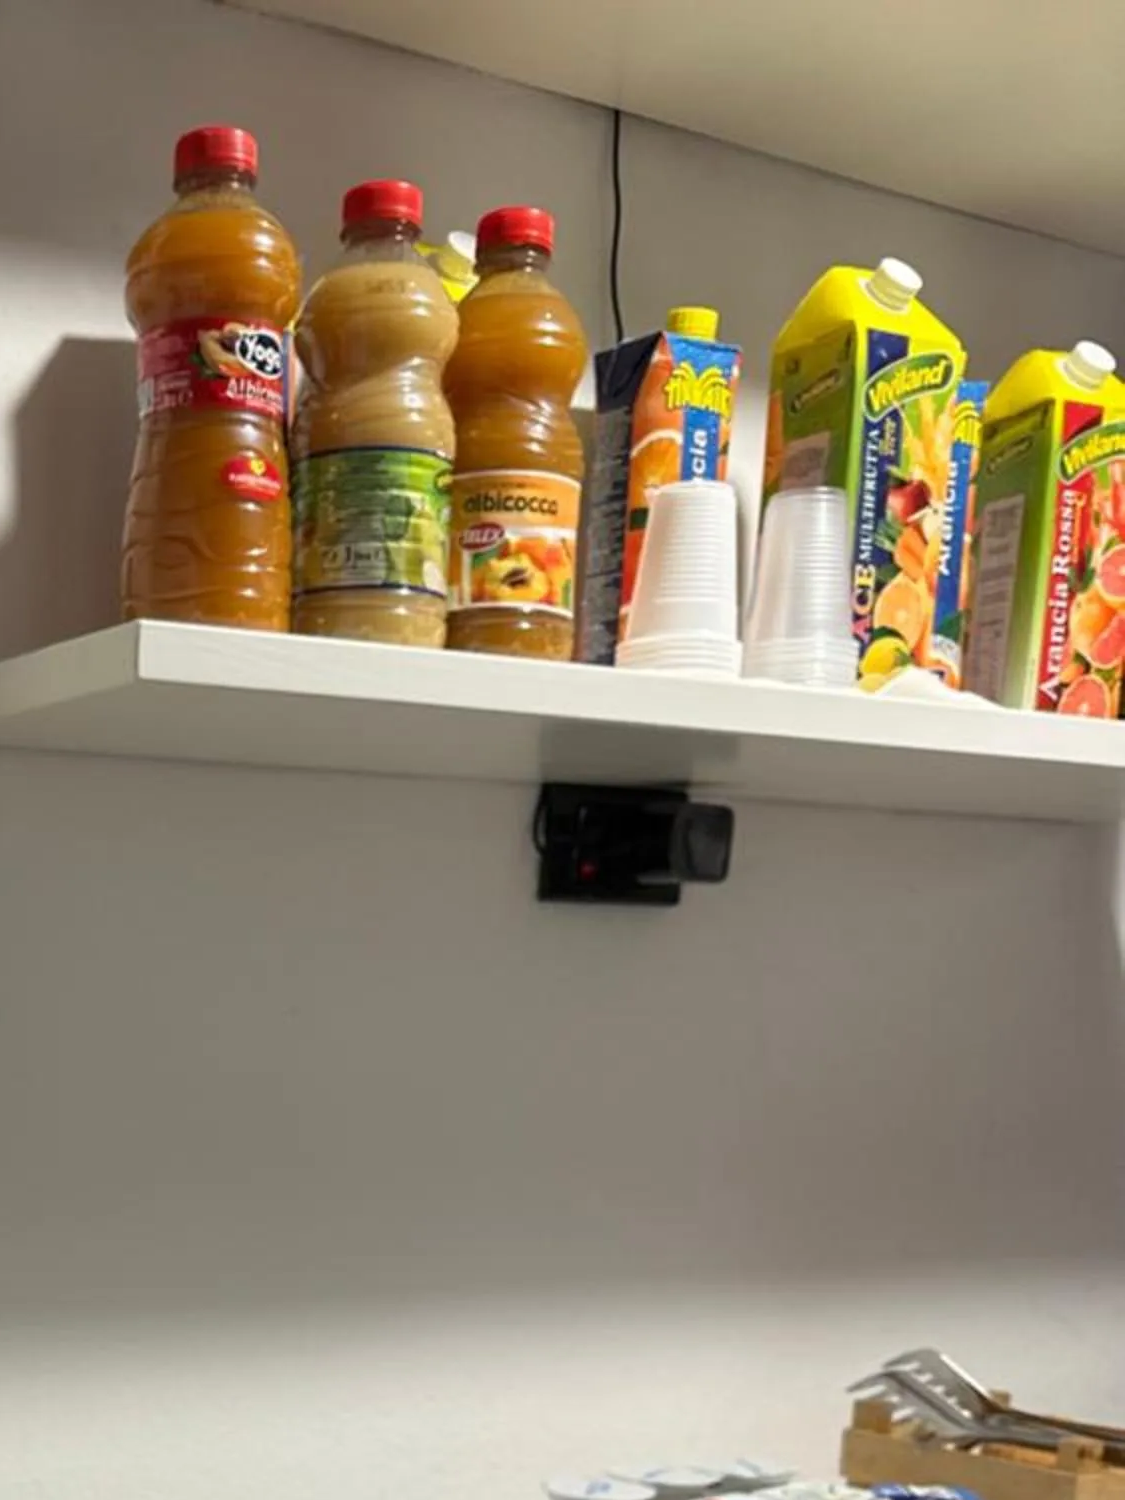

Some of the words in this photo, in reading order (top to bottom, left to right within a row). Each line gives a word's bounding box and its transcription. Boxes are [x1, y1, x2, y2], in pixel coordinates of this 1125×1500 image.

[868, 359, 948, 412] Viviland
[463, 491, 559, 516] albicocca
[858, 429, 880, 562] MULTIFRUTTA
[1051, 489, 1077, 574] Rossa
[1038, 581, 1069, 701] Arancia
